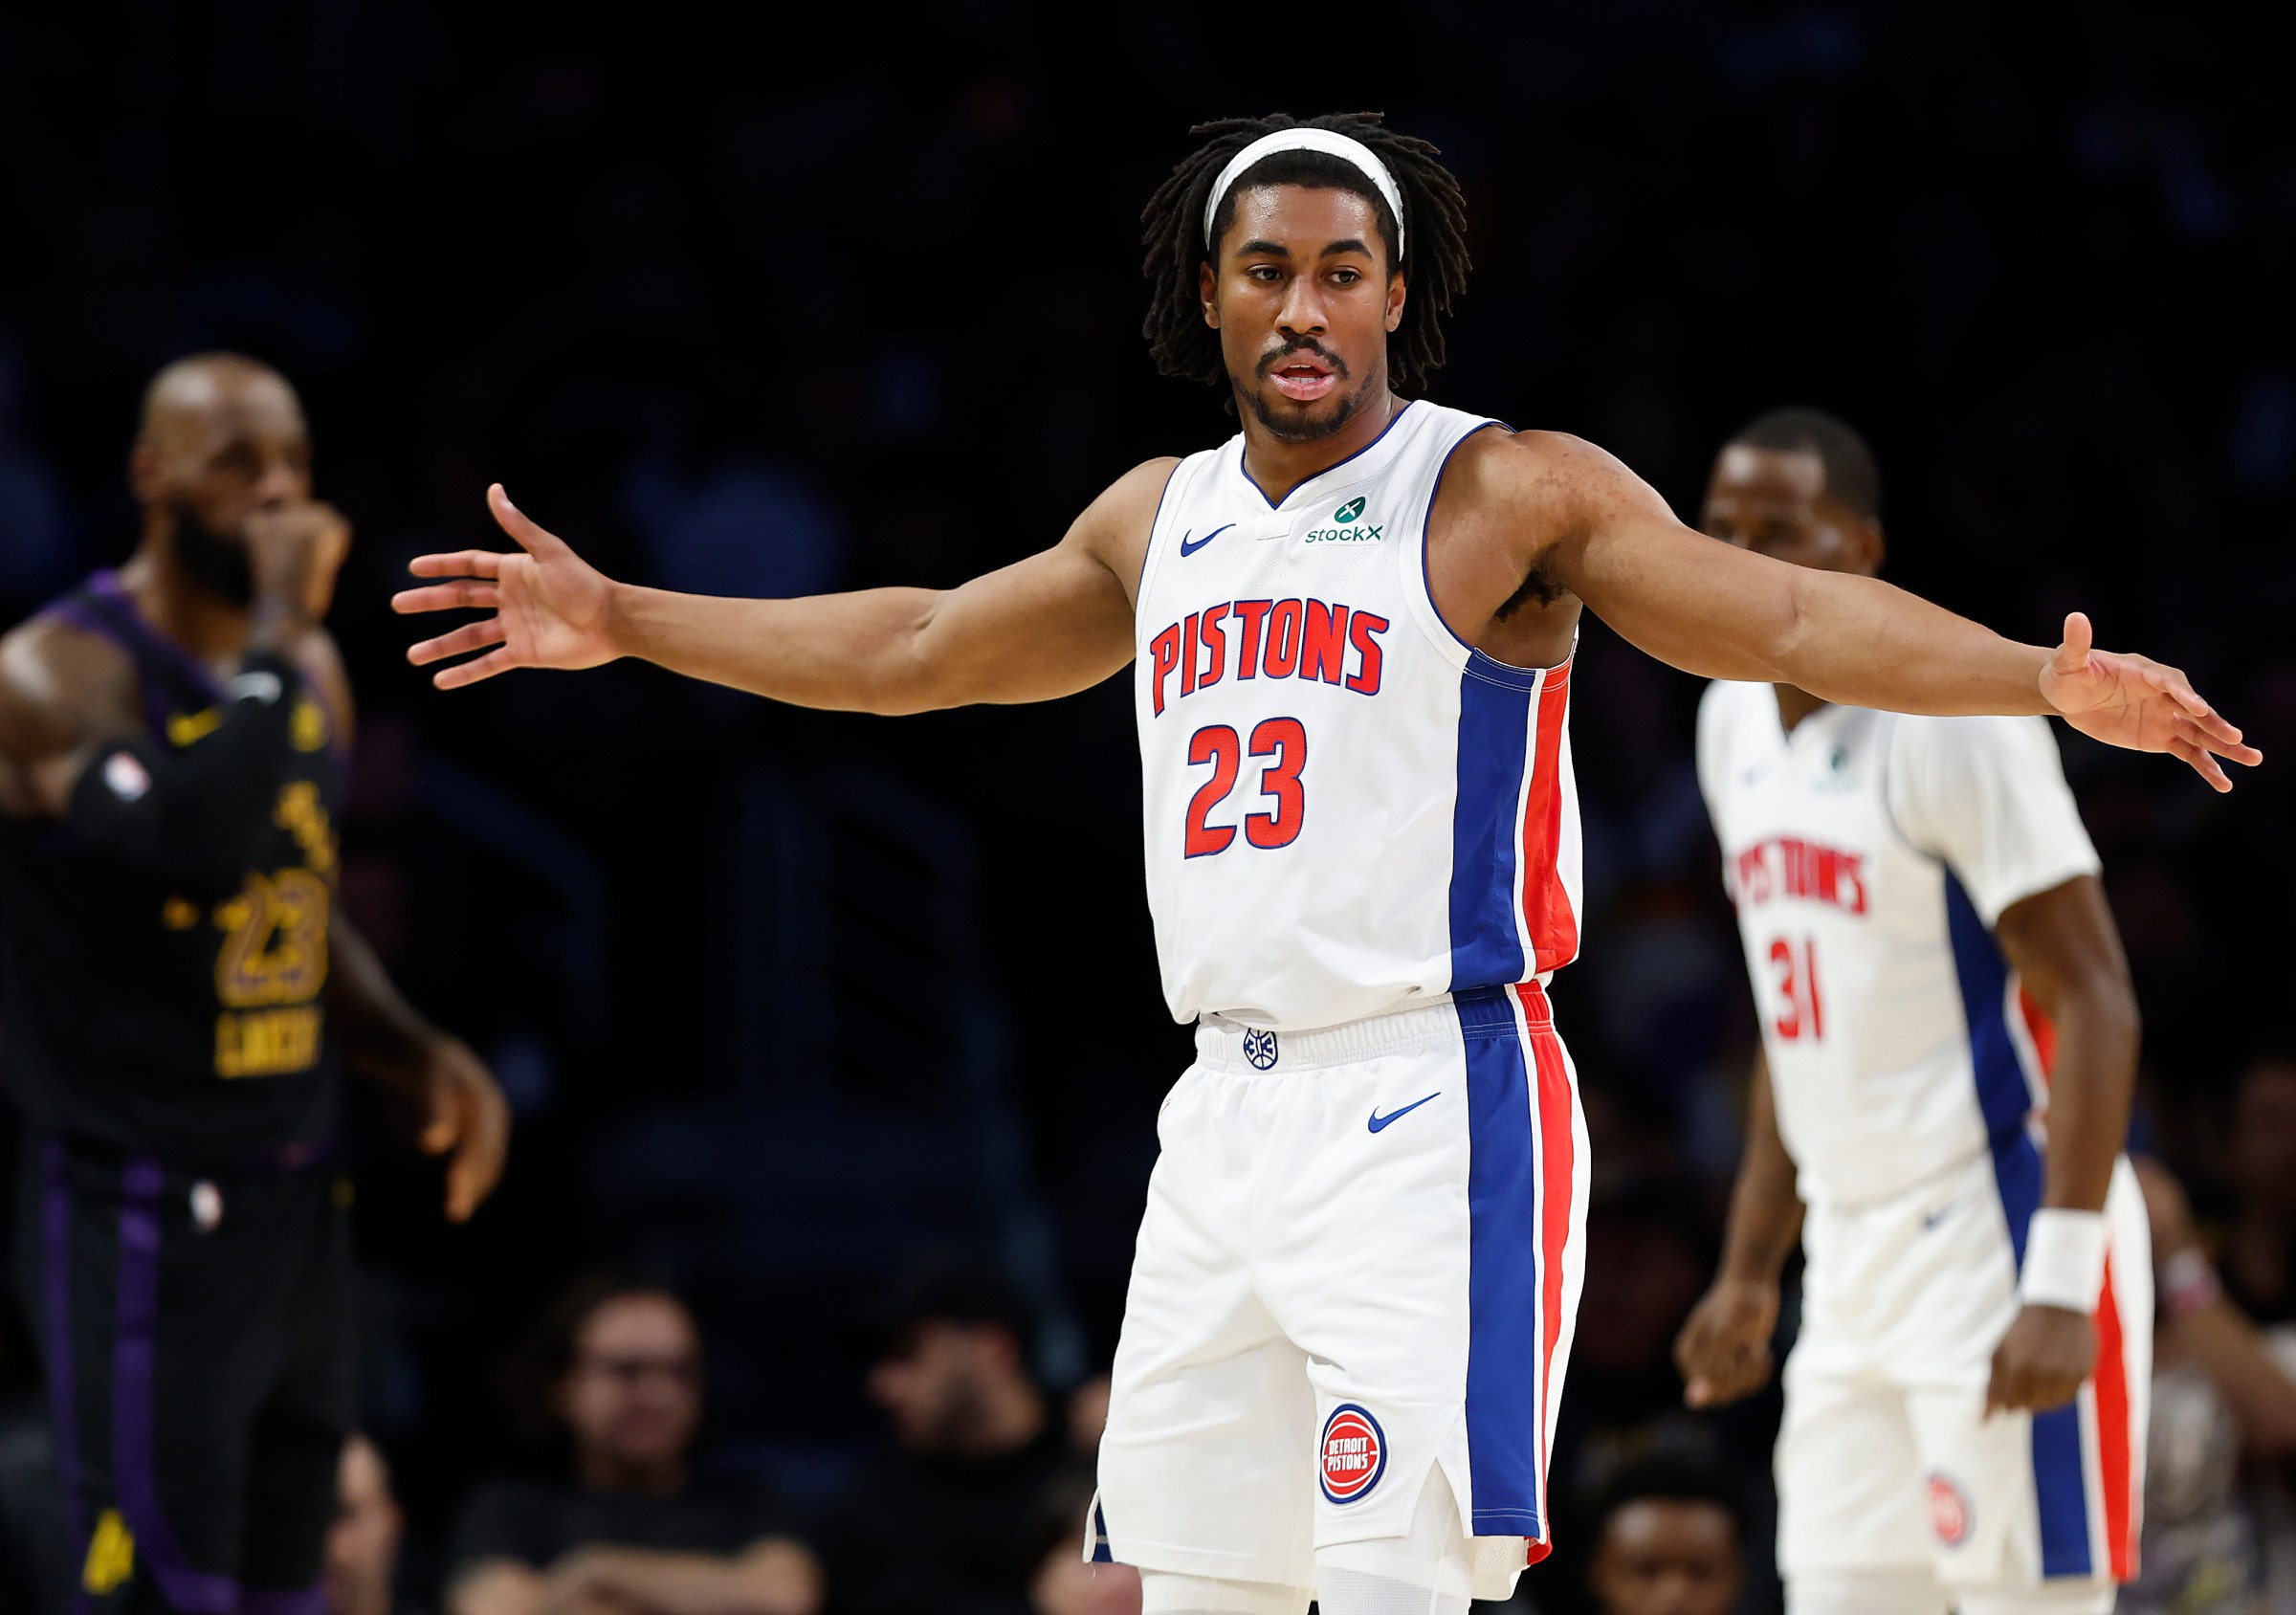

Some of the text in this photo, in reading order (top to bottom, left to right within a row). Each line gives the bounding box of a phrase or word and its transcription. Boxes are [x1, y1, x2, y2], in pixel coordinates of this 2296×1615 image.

[1150, 597, 1390, 719] PISTONS
[1184, 716, 1308, 859] 23
[1768, 937, 1823, 1042] 31
[1327, 1452, 1369, 1472] PISTONS
[1328, 1436, 1369, 1456] DETROIT
